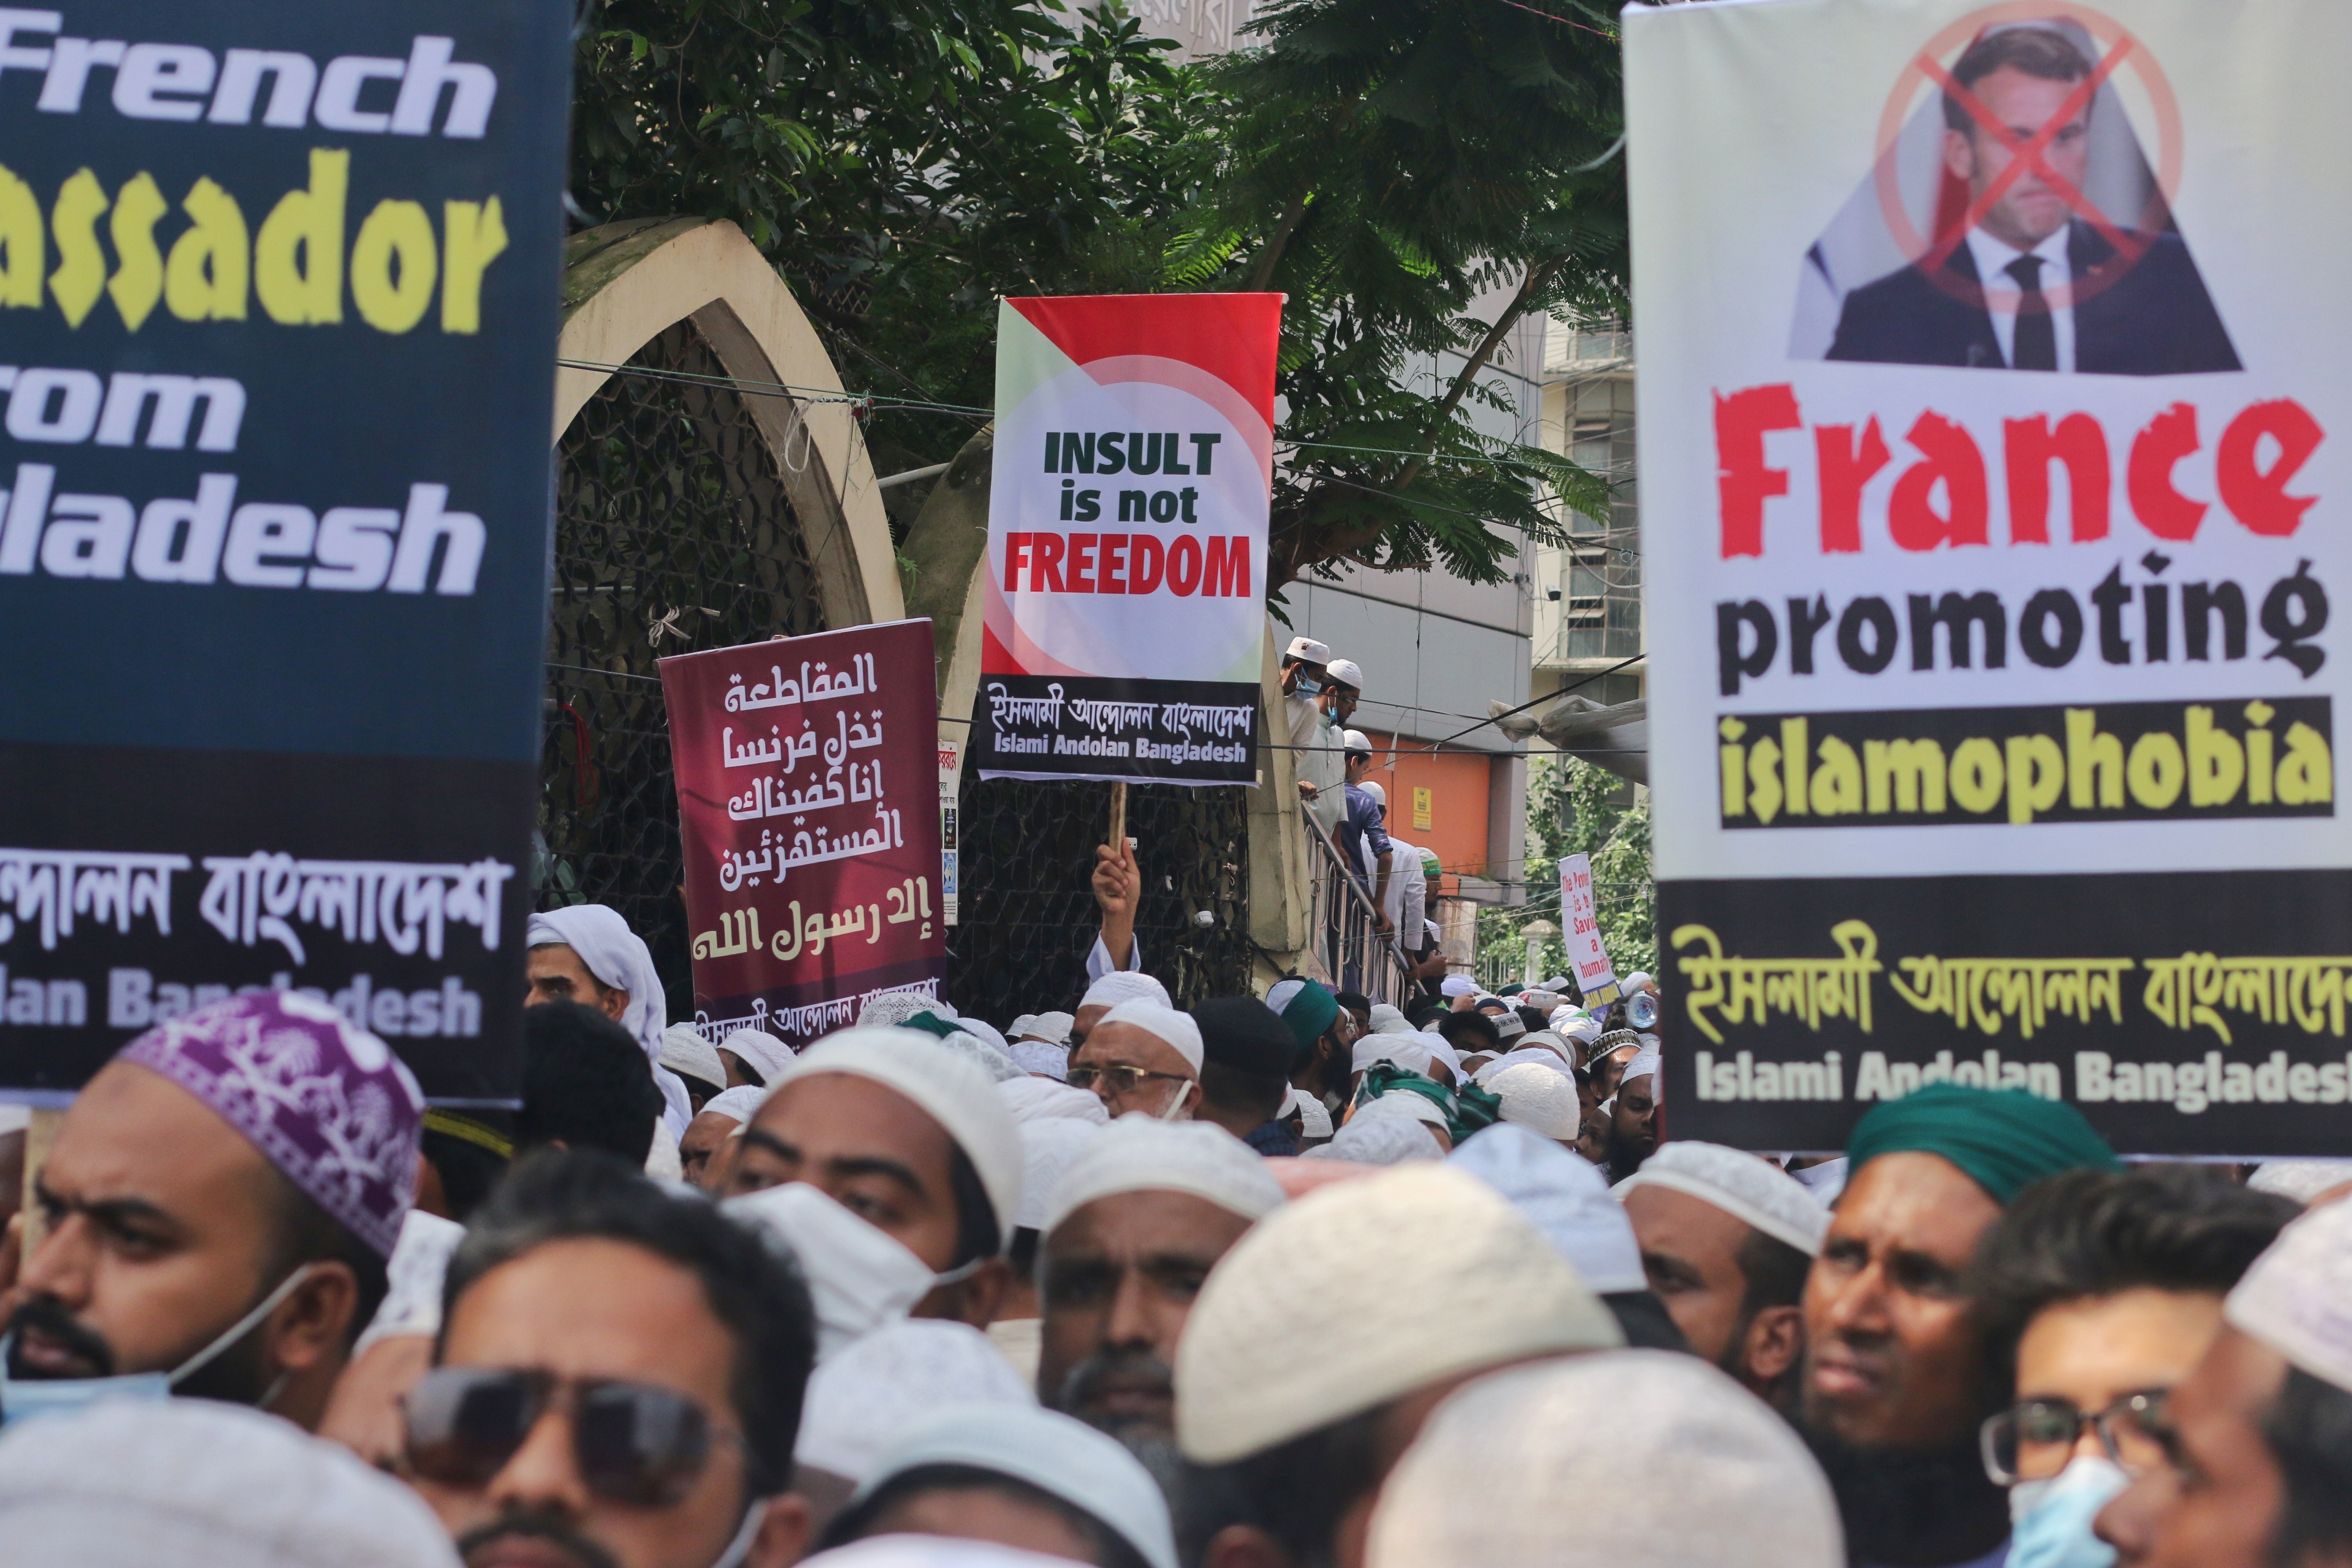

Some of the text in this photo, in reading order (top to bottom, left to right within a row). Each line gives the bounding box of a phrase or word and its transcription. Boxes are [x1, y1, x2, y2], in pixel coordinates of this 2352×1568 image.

[0, 7, 498, 139] French
[0, 365, 247, 452] om
[1044, 431, 1221, 475] INSULT
[1714, 383, 2325, 560] France
[0, 462, 487, 596] ladesh
[1060, 478, 1199, 524] is not
[1004, 532, 1251, 597] FREEDOM
[1716, 550, 2331, 696] promoting
[725, 653, 878, 712] المقاطعة
[987, 682, 1255, 740] ইসলামী আন্দোলন বাংলাদেশ
[723, 709, 882, 774] تذل فرنسا
[994, 732, 1246, 764] Islami Andolan Bangladesh
[1719, 701, 2332, 825] islamophobia
[728, 765, 845, 826] كفيناك
[200, 851, 514, 964] বাংলাদেশ
[693, 876, 932, 961] إلا رسول الله
[1672, 920, 2352, 1043] ইসলামী আন্দোলন বাংলাদে
[772, 995, 856, 1036] আন্দোলন
[1695, 1051, 1843, 1101] Islami
